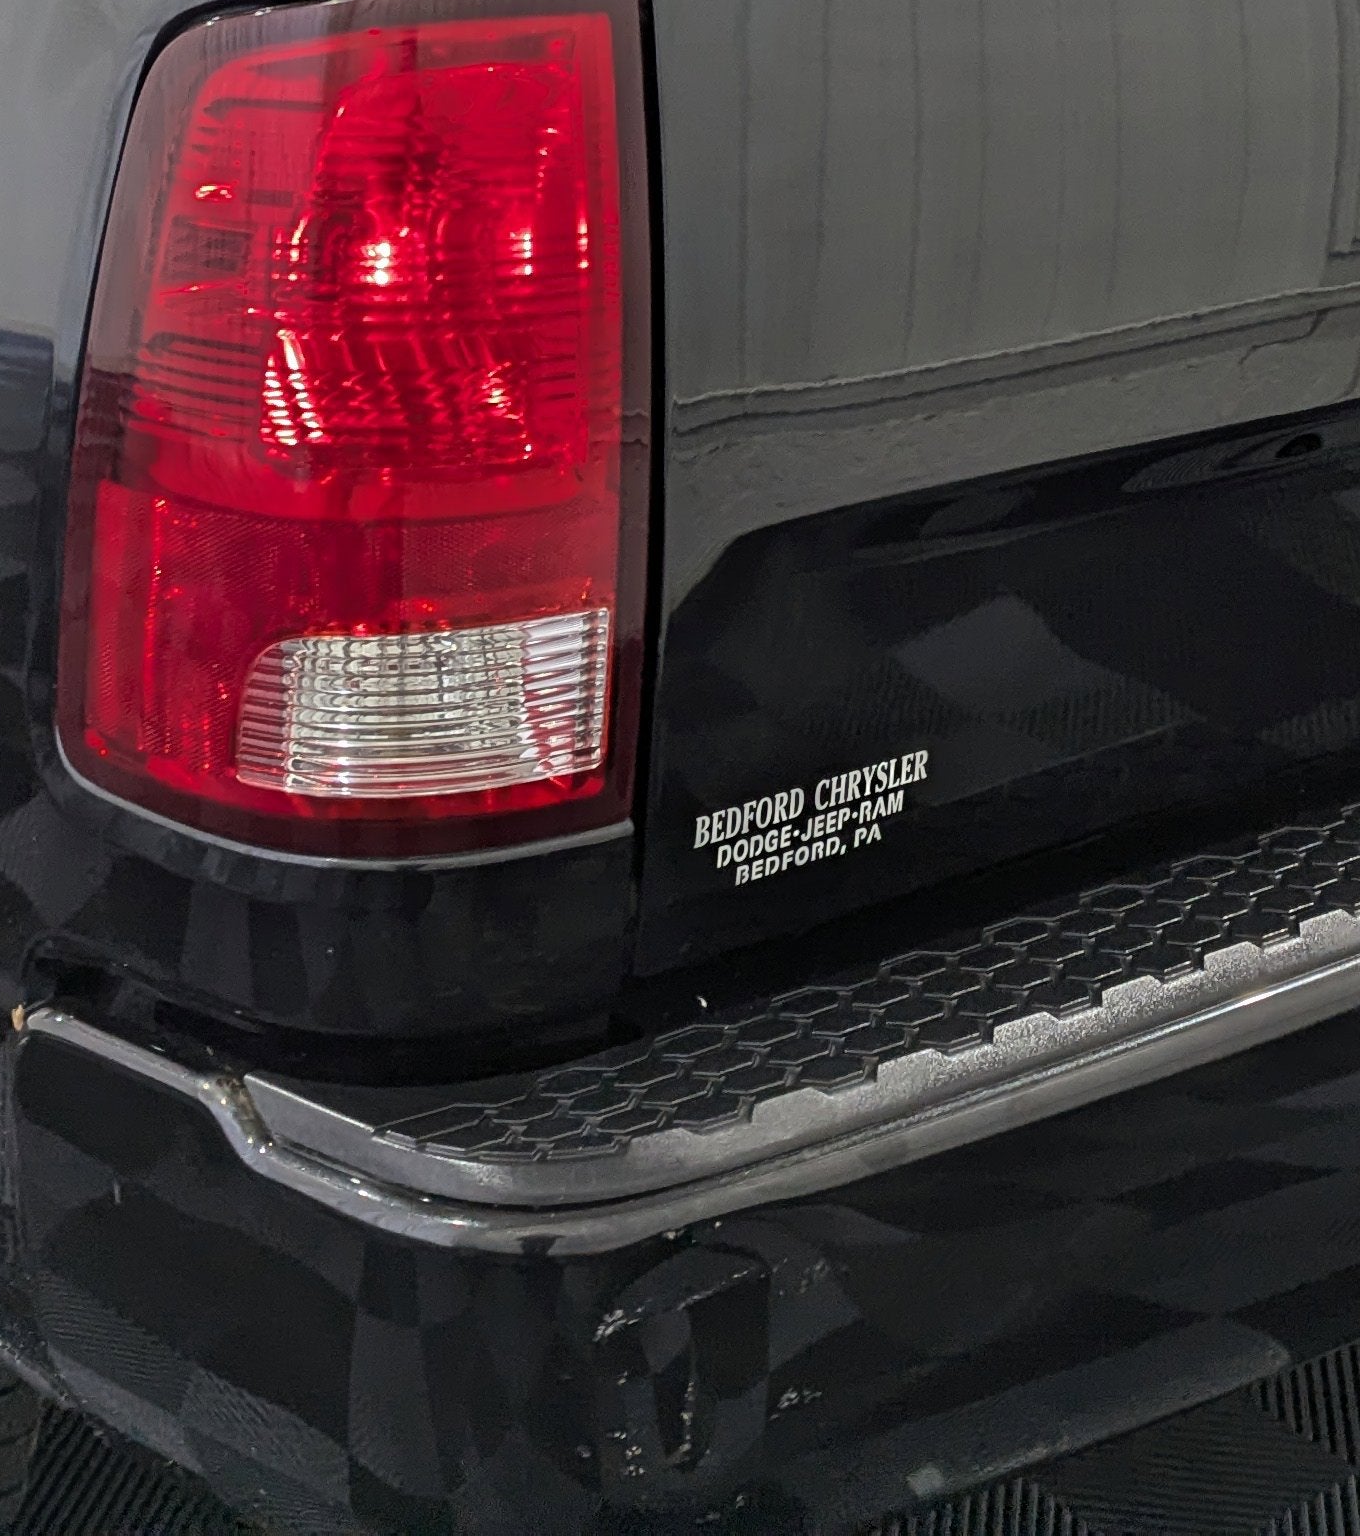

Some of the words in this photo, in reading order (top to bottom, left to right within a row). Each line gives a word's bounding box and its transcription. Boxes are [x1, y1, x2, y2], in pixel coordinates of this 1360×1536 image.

[693, 787, 805, 849] BEDFORD
[814, 749, 929, 811] CHRYSLER
[734, 835, 848, 887] BEDFORD,
[853, 823, 883, 849] PA
